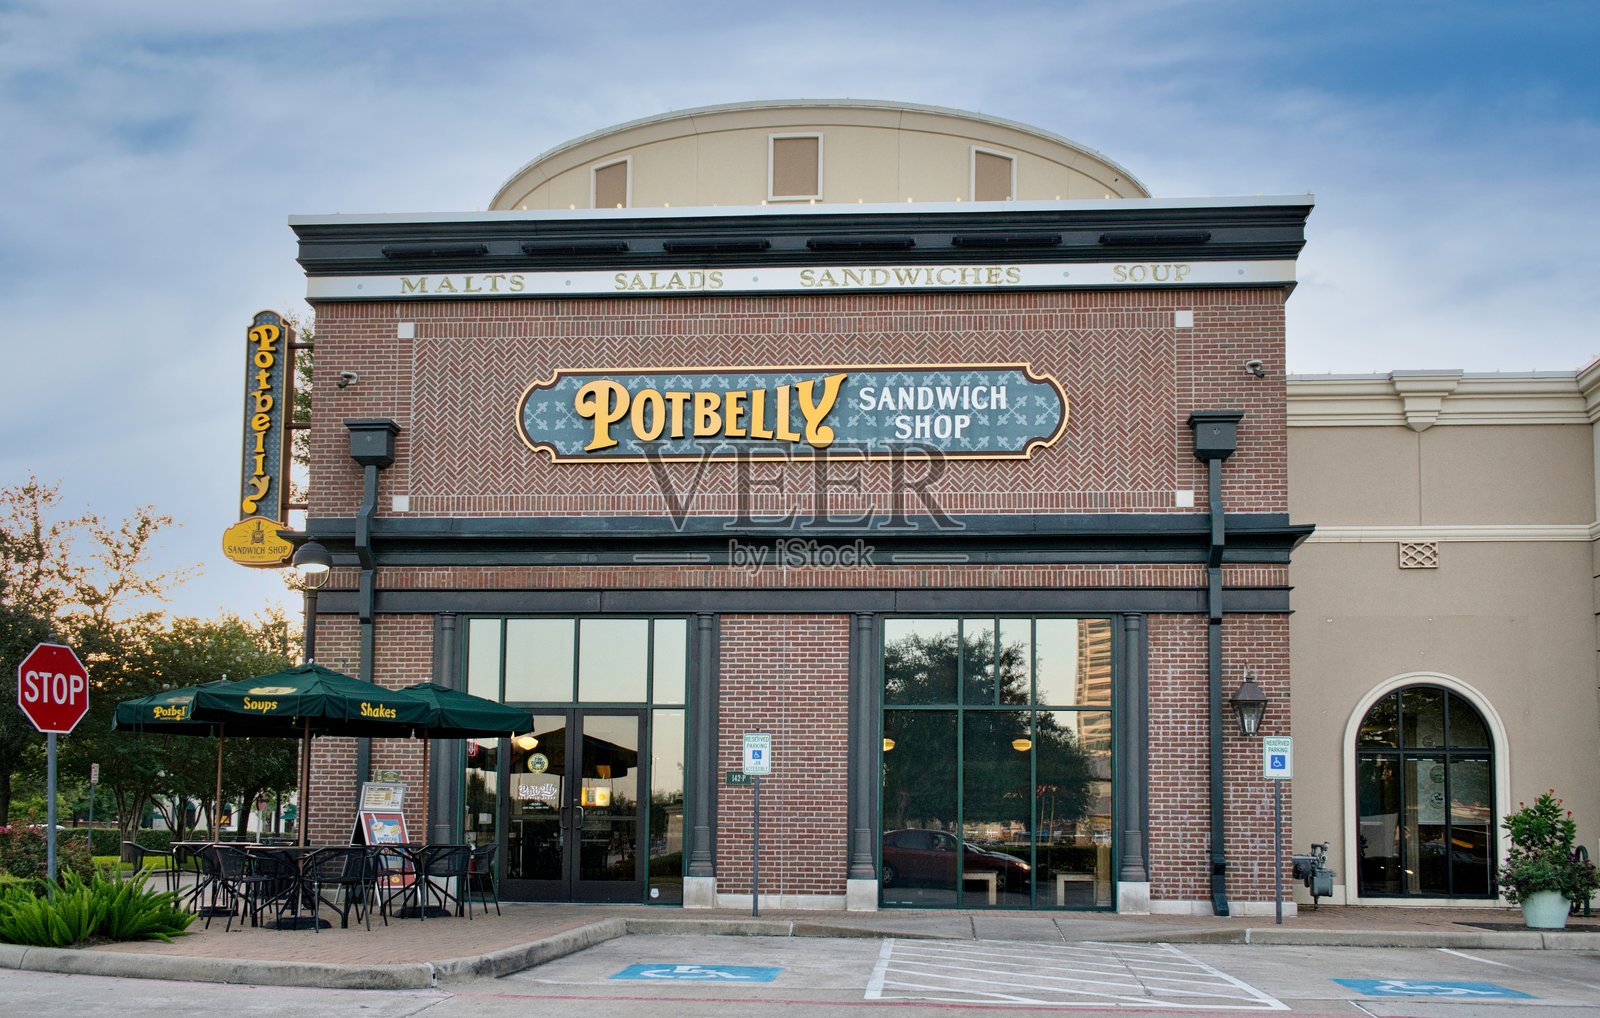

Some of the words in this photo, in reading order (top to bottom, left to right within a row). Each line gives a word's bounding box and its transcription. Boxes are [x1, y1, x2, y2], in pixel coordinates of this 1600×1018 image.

[614, 270, 725, 291] SALADS
[799, 266, 1022, 288] SANDWICHES
[1113, 263, 1192, 283] SOUP
[400, 275, 526, 295] MALTS
[859, 385, 1008, 412] SANDWICH
[894, 413, 972, 440] SHOP
[227, 545, 266, 555] SANDWICH
[268, 545, 288, 555] SHOP
[24, 670, 85, 706] STOP
[243, 696, 278, 714] Soups
[360, 702, 397, 719] Shakes
